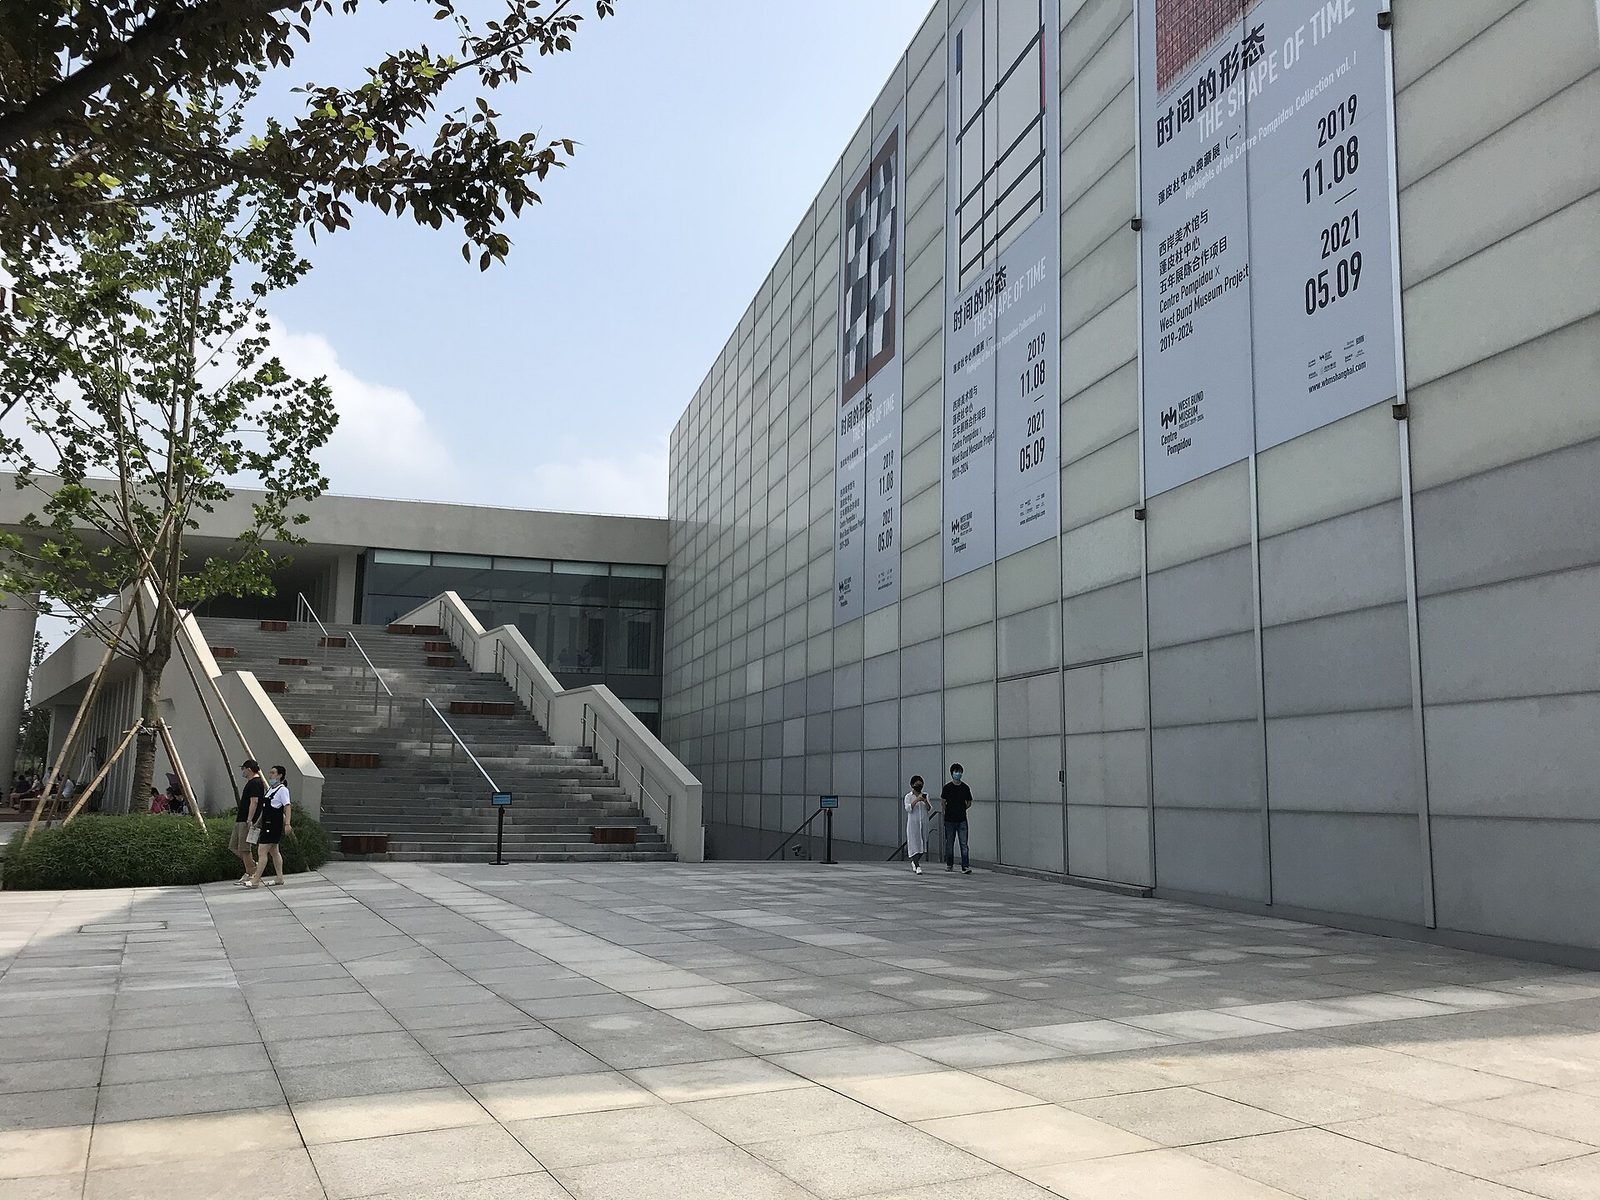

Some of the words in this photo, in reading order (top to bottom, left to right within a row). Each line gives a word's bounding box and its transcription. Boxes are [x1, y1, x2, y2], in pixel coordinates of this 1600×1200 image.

[1156, 23, 1265, 148] 时间的形态
[1197, 96, 1224, 144] THE
[1228, 49, 1279, 118] SHAPE
[1283, 24, 1305, 70] OF
[1309, 0, 1356, 46] TIME
[1224, 152, 1234, 168] the
[1258, 104, 1294, 142] Pompidou
[1295, 72, 1334, 111] Collection
[1317, 93, 1358, 149] 2019
[1302, 135, 1359, 205] 11.08
[1159, 208, 1209, 258] 西岸美术馆与
[1159, 235, 1201, 277] 蓬皮杜中心
[1320, 208, 1360, 260] 2021
[953, 265, 1007, 333] 时间的形态
[973, 308, 987, 338] THE
[1013, 275, 1025, 302] OF
[1026, 256, 1047, 292] TIME
[1159, 292, 1180, 314] Centre
[1180, 268, 1214, 300] Pompidou
[1304, 250, 1363, 316] 05.09
[1159, 312, 1176, 333] West
[1176, 299, 1193, 323] Bund
[1194, 284, 1223, 312] Museum
[1026, 331, 1046, 362] 2019
[1159, 320, 1194, 353] 2019-2024
[1020, 358, 1046, 398] 11.08
[1027, 408, 1045, 438] 2021
[1019, 436, 1046, 473] 05.09
[878, 470, 894, 497] 11.08
[877, 526, 893, 553] 05.09
